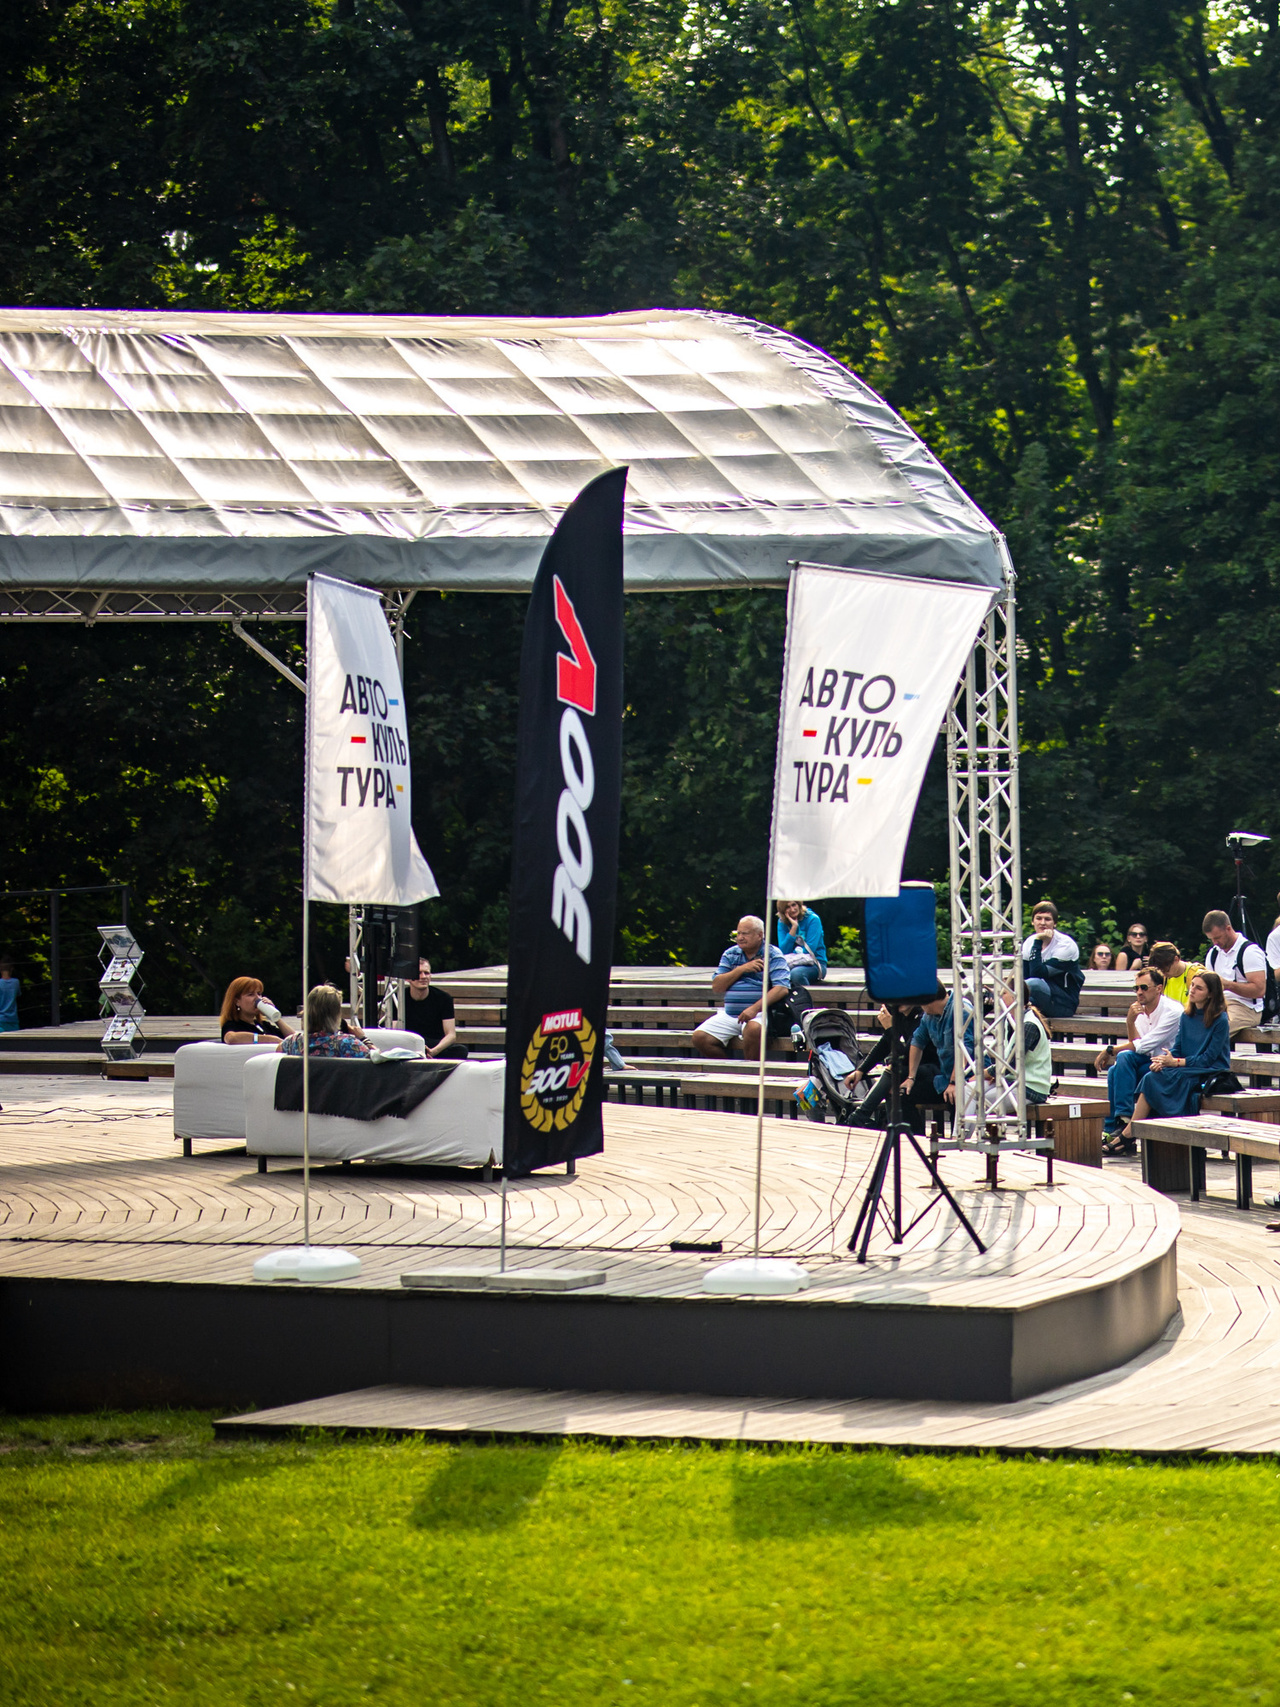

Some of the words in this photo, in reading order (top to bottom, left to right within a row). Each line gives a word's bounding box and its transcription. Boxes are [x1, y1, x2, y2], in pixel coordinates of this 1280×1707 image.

[551, 573, 597, 966] 300V
[543, 1011, 581, 1032] MOTUL
[549, 1035, 569, 1062] 50
[524, 1060, 591, 1095] 300V
